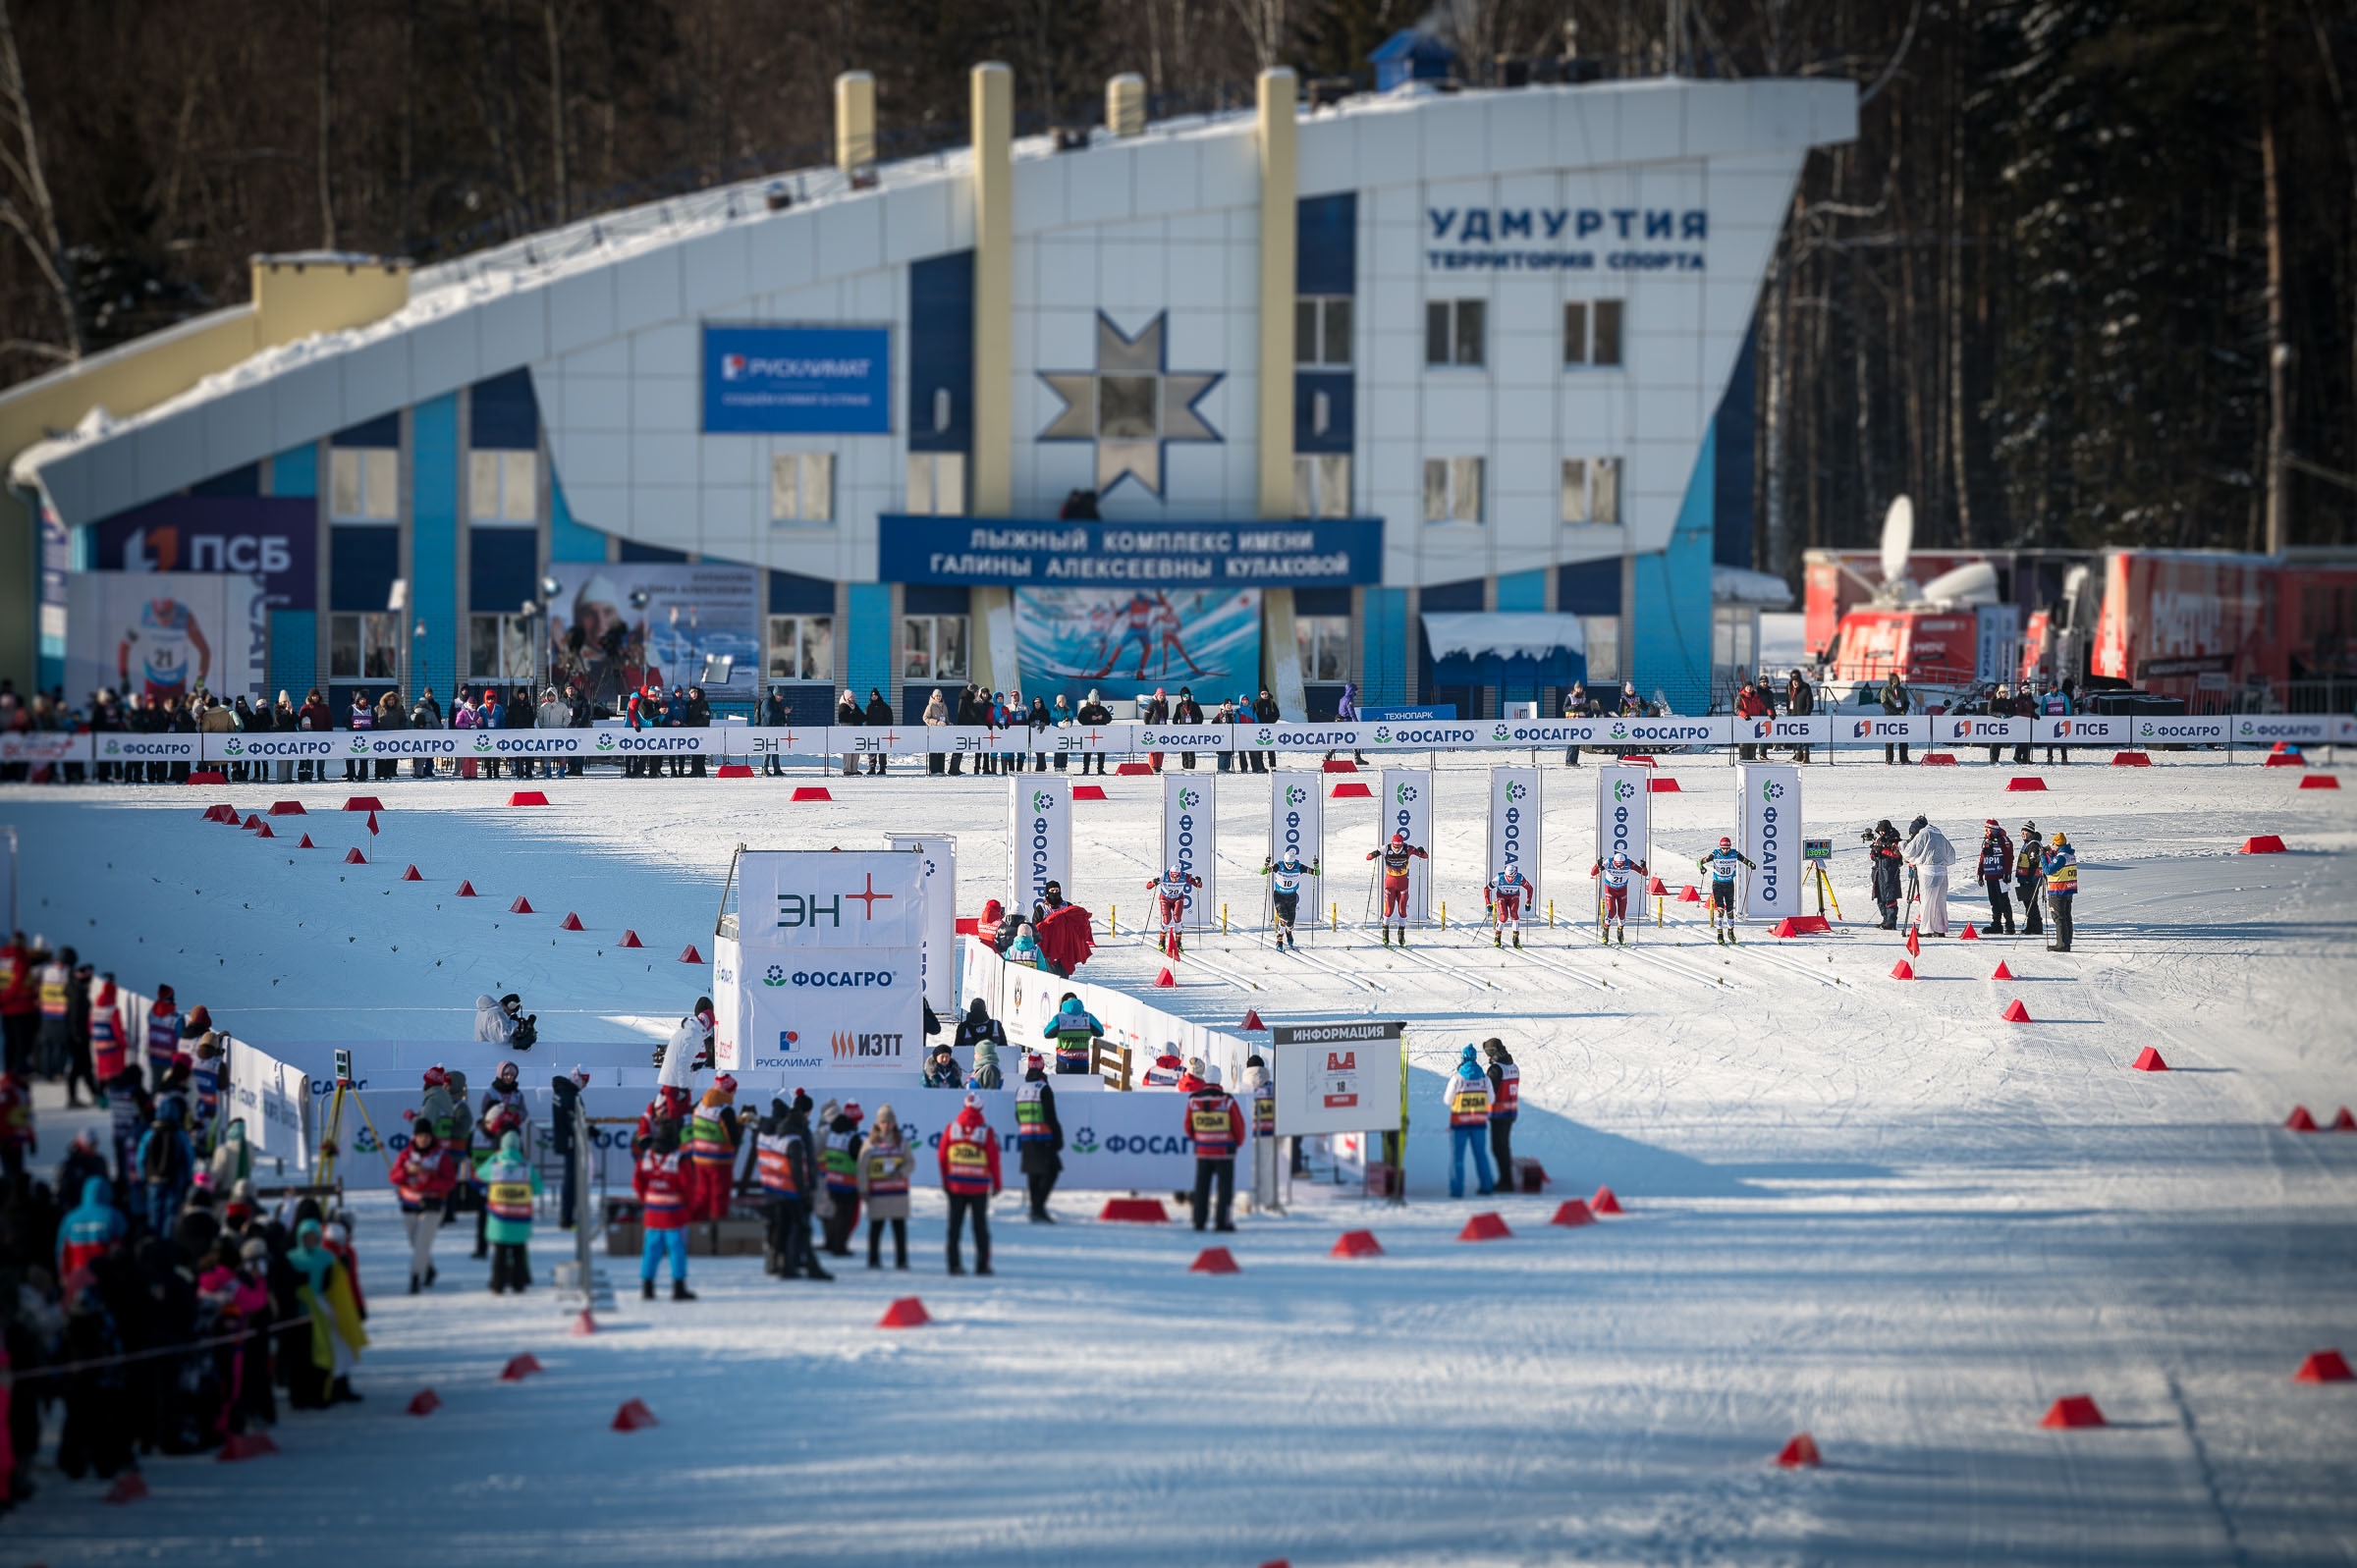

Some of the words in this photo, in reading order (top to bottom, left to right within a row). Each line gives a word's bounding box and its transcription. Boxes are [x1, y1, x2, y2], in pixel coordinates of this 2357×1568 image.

[1428, 208, 1709, 243] УДМУРТИЯ
[1429, 252, 1595, 271] ТЕРРИТОРИЯ
[1607, 252, 1706, 271] СПОРТА
[970, 528, 1086, 551] ЛЫЖНЫЙ
[1103, 531, 1232, 553] КОМПЛЕКС
[1238, 531, 1314, 551] ИМЕНИ
[191, 536, 291, 571] ПСБ
[930, 555, 1031, 575] ГАЛИНЫ
[1045, 558, 1212, 577] АЛЕКСЕЕВНЫ
[1225, 553, 1348, 576] КУЛАКОВОЙ
[154, 649, 173, 669] 21
[1384, 711, 1434, 721] ТЕХНОПАРК
[1396, 730, 1474, 742] ФОСАГРО
[1514, 728, 1593, 740] ФОСАГРО
[1631, 727, 1709, 739] ФОСАГРО
[1776, 724, 1810, 735] ПСБ
[1876, 724, 1909, 735] ПСБ
[1975, 724, 2009, 735] ПСБ
[2075, 724, 2109, 735] ПСБ
[2158, 726, 2220, 736] ФОСАГРО
[2257, 726, 2322, 735] ФОСАГРО
[496, 738, 577, 751] ФОСАГРО
[619, 736, 699, 750] ФОСАГРО
[1158, 734, 1222, 745] ФОСАГРО
[1278, 731, 1356, 745] ФОСАГРО
[123, 743, 191, 755] ФОСАГРО
[247, 741, 331, 755] ФОСАГРО
[372, 739, 456, 753] ФОСАГРО
[1762, 806, 1779, 901] ФОСАГРО
[1178, 814, 1194, 909] ФОСАРО
[792, 971, 893, 987] ФОСАГРО
[1292, 1026, 1385, 1041] ИНФОРМАЦИЯ
[858, 1034, 903, 1056] ИЗТТ
[755, 1058, 823, 1067] РУСКЛИМАТ
[1337, 1081, 1345, 1092] 18
[1105, 1134, 1193, 1155] ФОСАГ
